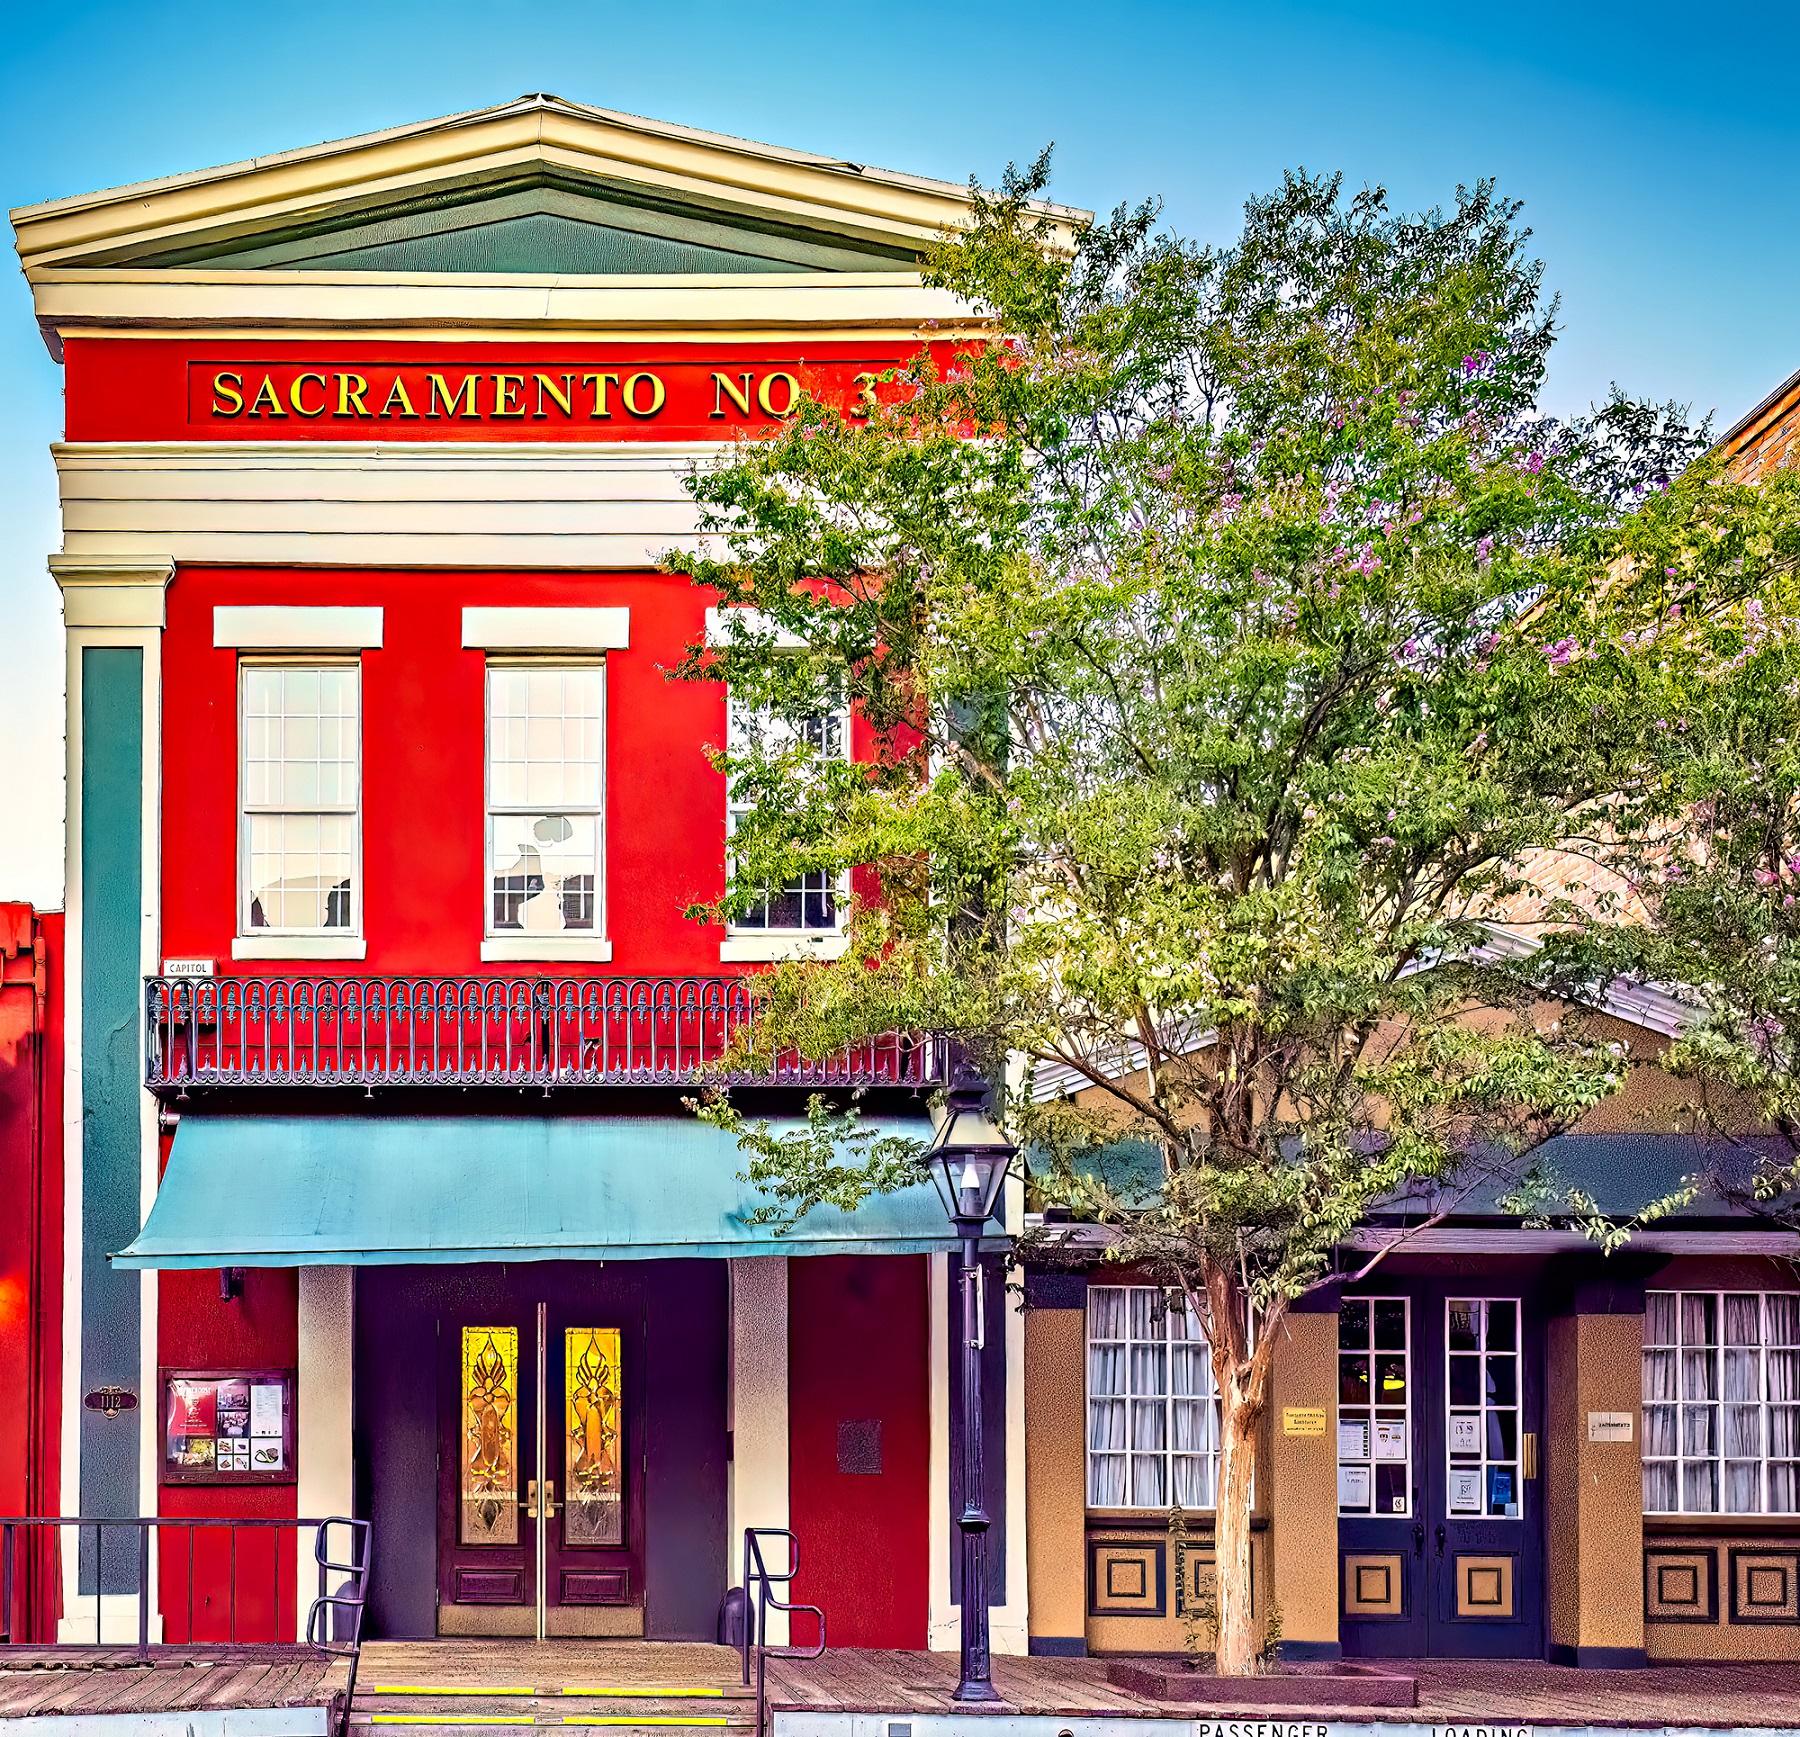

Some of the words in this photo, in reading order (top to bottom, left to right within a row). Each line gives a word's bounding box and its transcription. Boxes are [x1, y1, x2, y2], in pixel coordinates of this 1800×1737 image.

[211, 371, 667, 419] SACRAMENTO
[710, 372, 801, 418] NO
[850, 372, 879, 418] 3
[170, 964, 206, 973] CAPITOL
[101, 1395, 121, 1408] 1112
[1199, 1724, 1328, 1737] PASSENGER
